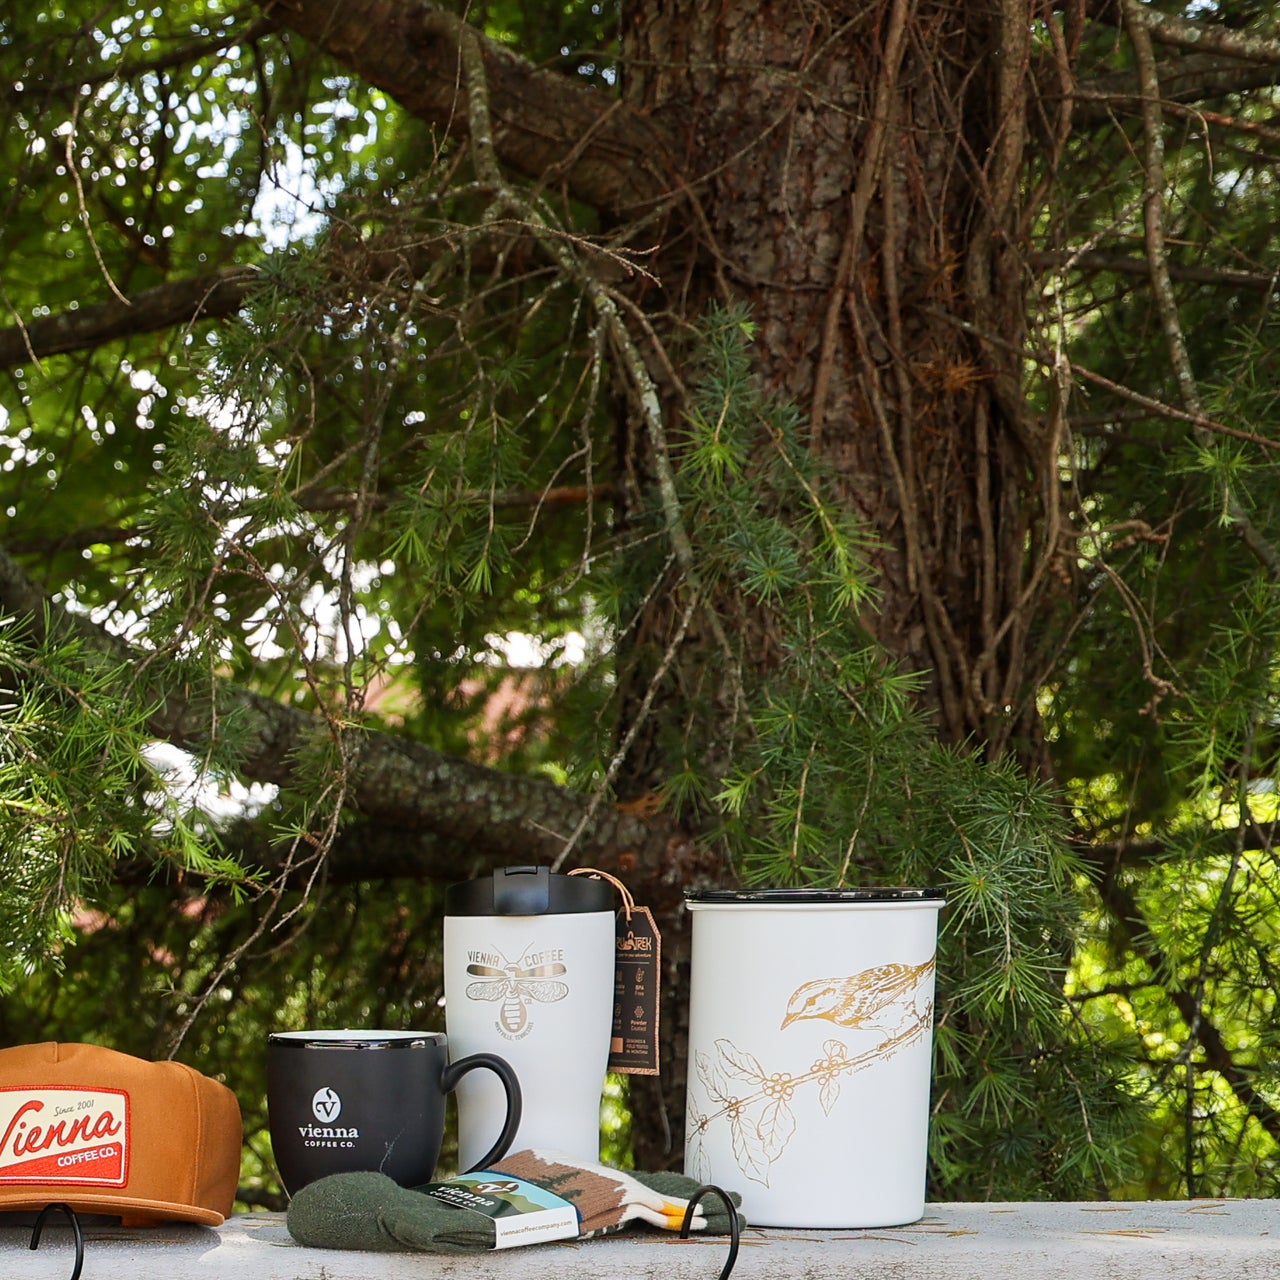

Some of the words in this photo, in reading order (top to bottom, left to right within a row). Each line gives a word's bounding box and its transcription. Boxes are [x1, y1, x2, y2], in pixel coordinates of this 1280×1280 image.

[467, 951, 500, 967] VIENNA
[524, 949, 564, 967] COFFEE
[53, 1106, 74, 1117] Since
[77, 1099, 95, 1111] 2001
[298, 1123, 360, 1138] vienna
[304, 1140, 338, 1148] COFFEE
[57, 1149, 100, 1167] COFFEE
[99, 1146, 118, 1159] CO.
[436, 1186, 495, 1207] vienna
[500, 1220, 573, 1237] viennacoffeecompany.com
